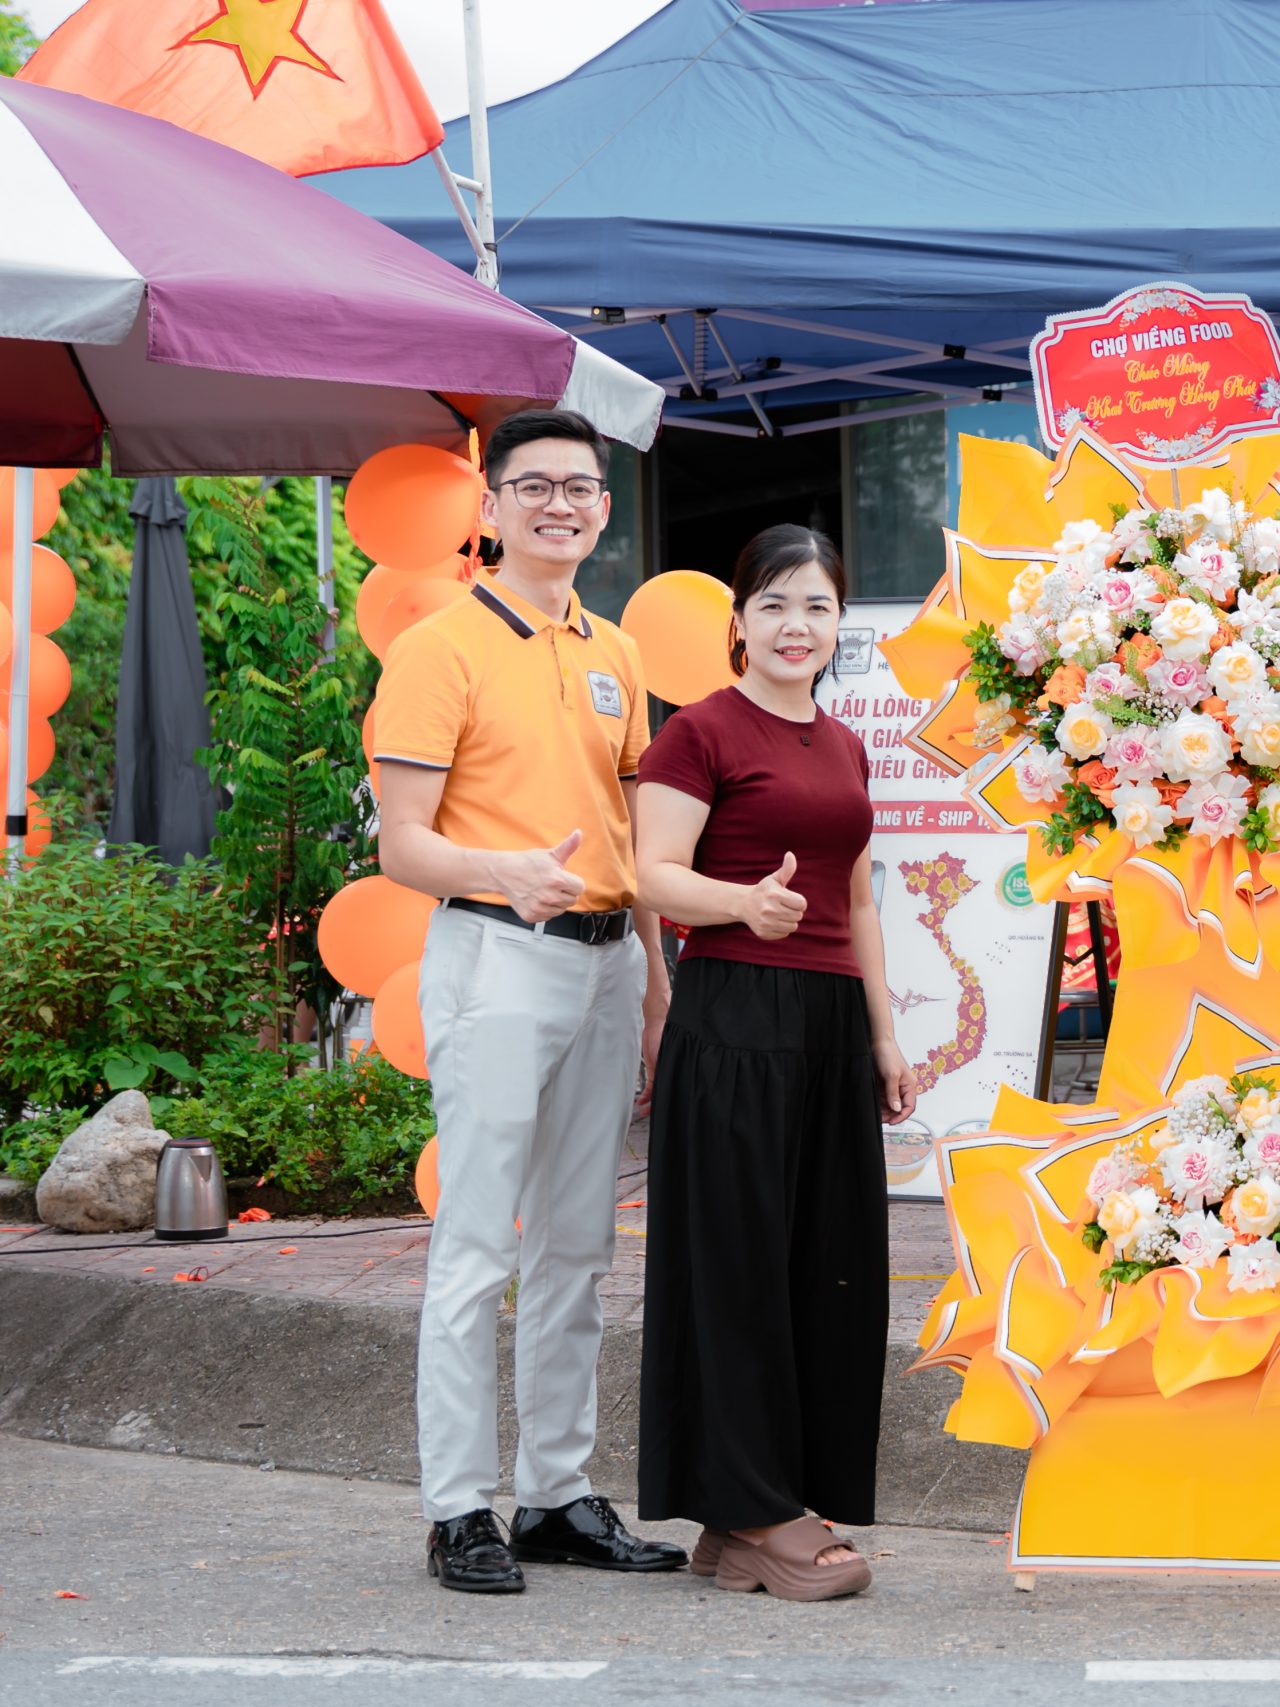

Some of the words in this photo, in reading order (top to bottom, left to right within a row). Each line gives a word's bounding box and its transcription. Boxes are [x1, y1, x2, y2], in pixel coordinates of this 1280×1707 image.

[1090, 334, 1128, 358] CHỢ
[1131, 325, 1187, 352] VIỀNG
[1190, 321, 1233, 343] FOOD
[1125, 360, 1160, 383] Chúc
[1163, 352, 1210, 381] Mừng
[1085, 395, 1123, 420] Khai
[831, 690, 867, 718] LẨU
[872, 693, 923, 718] LÒNG
[872, 722, 904, 748] GIẢ
[873, 810, 902, 826] ANG
[905, 805, 925, 827] VỀ
[938, 810, 974, 827] SHIP
